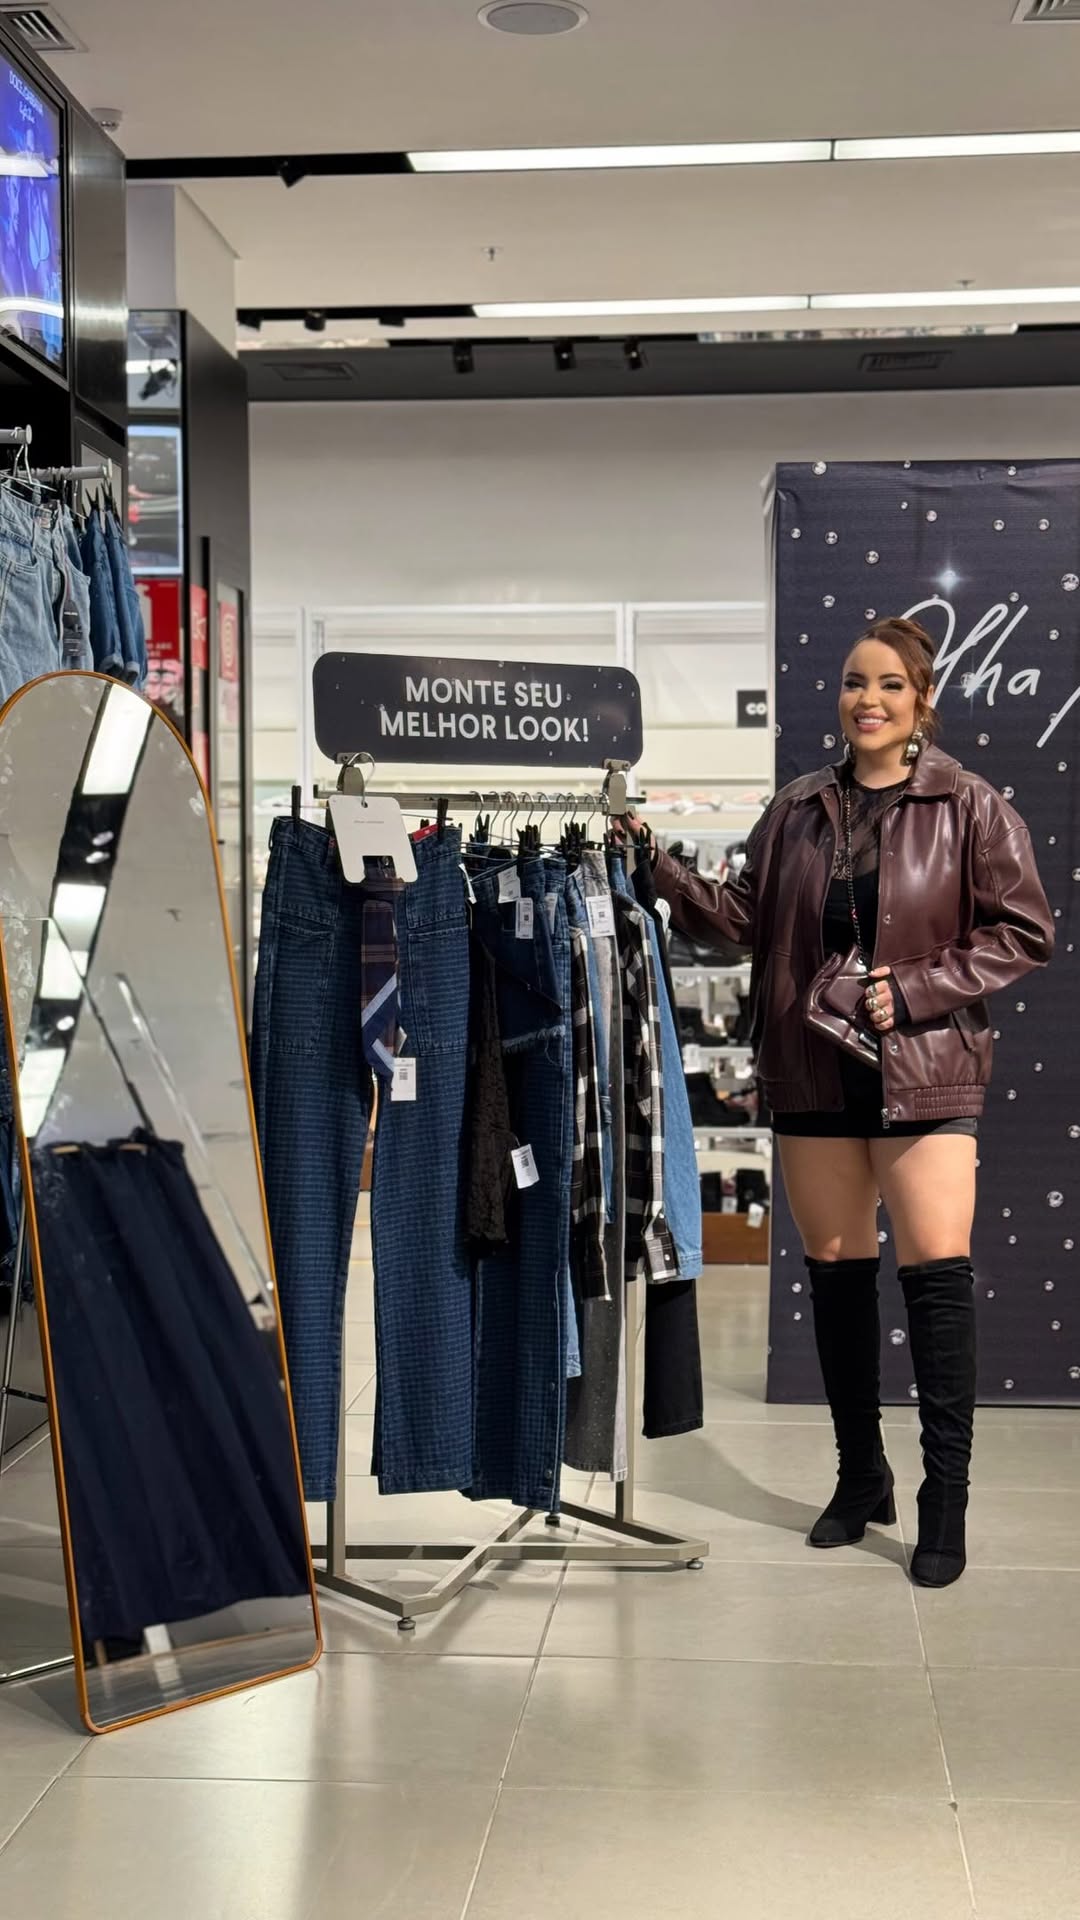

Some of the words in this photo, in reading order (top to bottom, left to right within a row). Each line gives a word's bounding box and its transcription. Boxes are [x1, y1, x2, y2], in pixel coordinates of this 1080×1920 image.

[405, 676, 507, 706] MONTE
[514, 681, 562, 708] SEU
[380, 711, 497, 739] MELHOR
[504, 715, 589, 742] LOOK!
